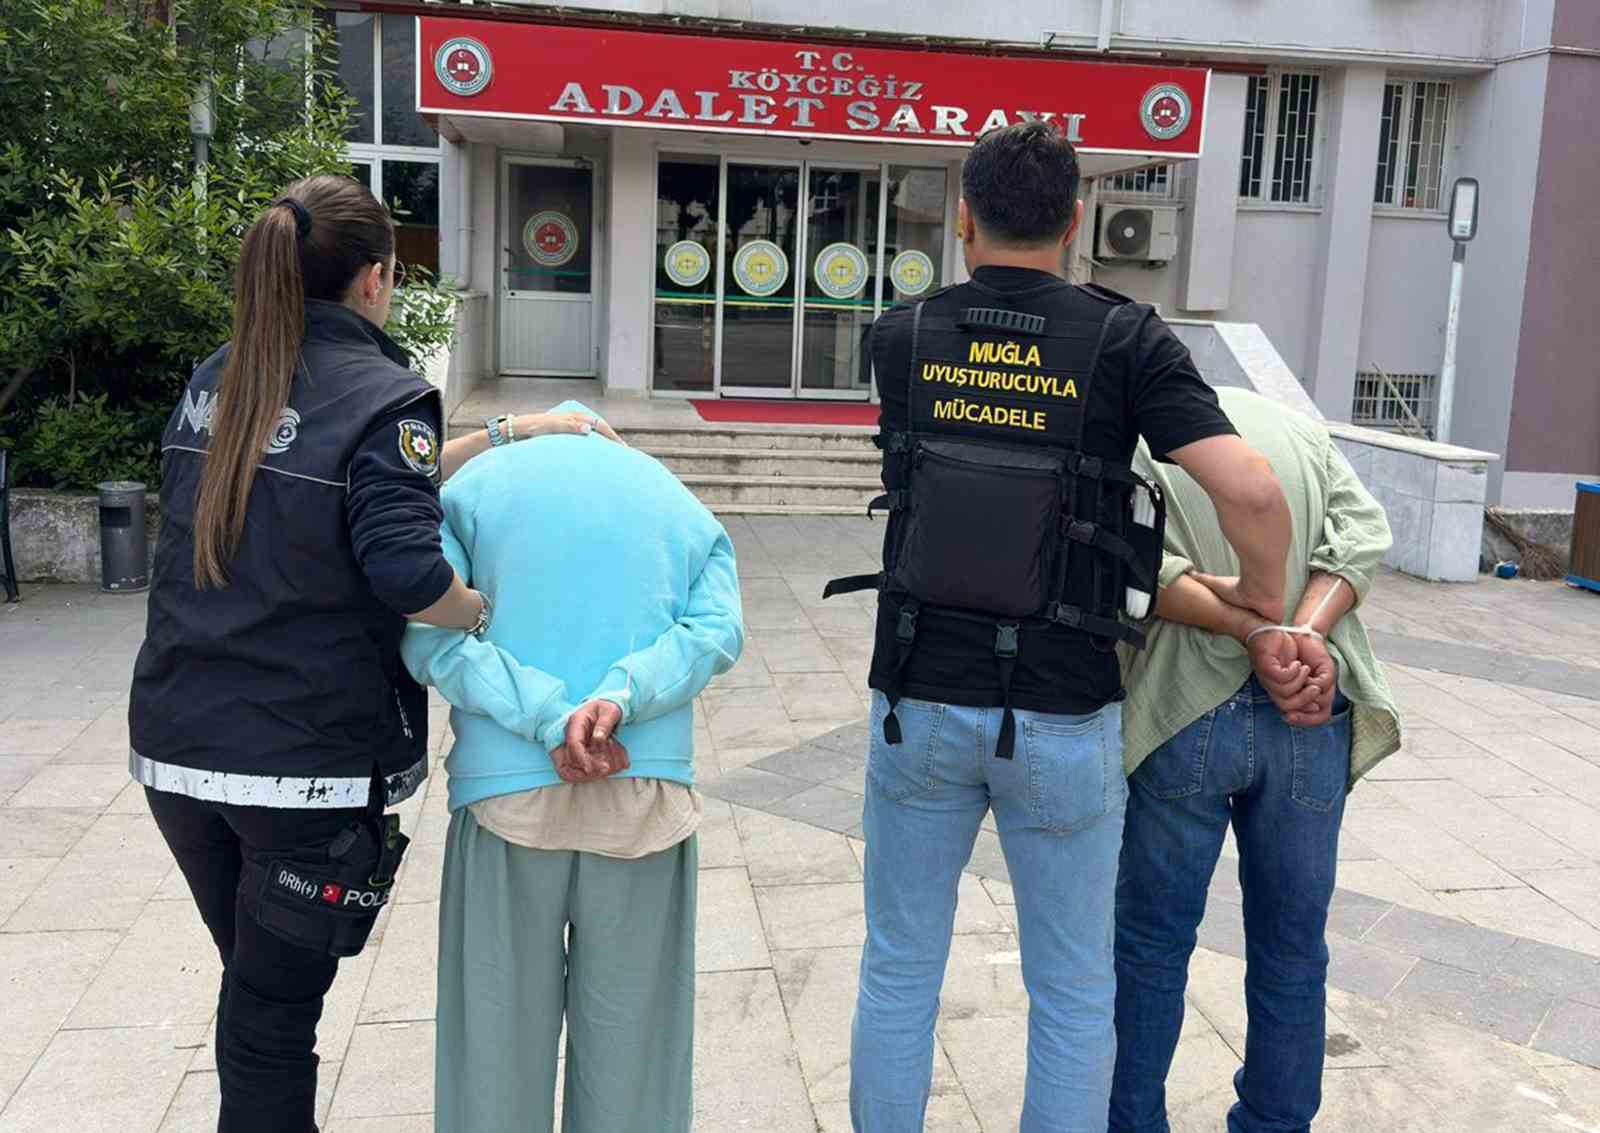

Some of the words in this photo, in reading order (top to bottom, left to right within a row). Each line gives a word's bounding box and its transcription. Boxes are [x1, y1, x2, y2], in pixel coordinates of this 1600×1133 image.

[728, 68, 923, 101] KÖYCEĞİZ
[549, 82, 825, 127] ADALET
[968, 341, 1041, 367] MUĞLA
[922, 364, 1078, 398] UYUŞTURUCUYLA
[933, 399, 1046, 430] MÜCADELE
[344, 889, 387, 907] POL
